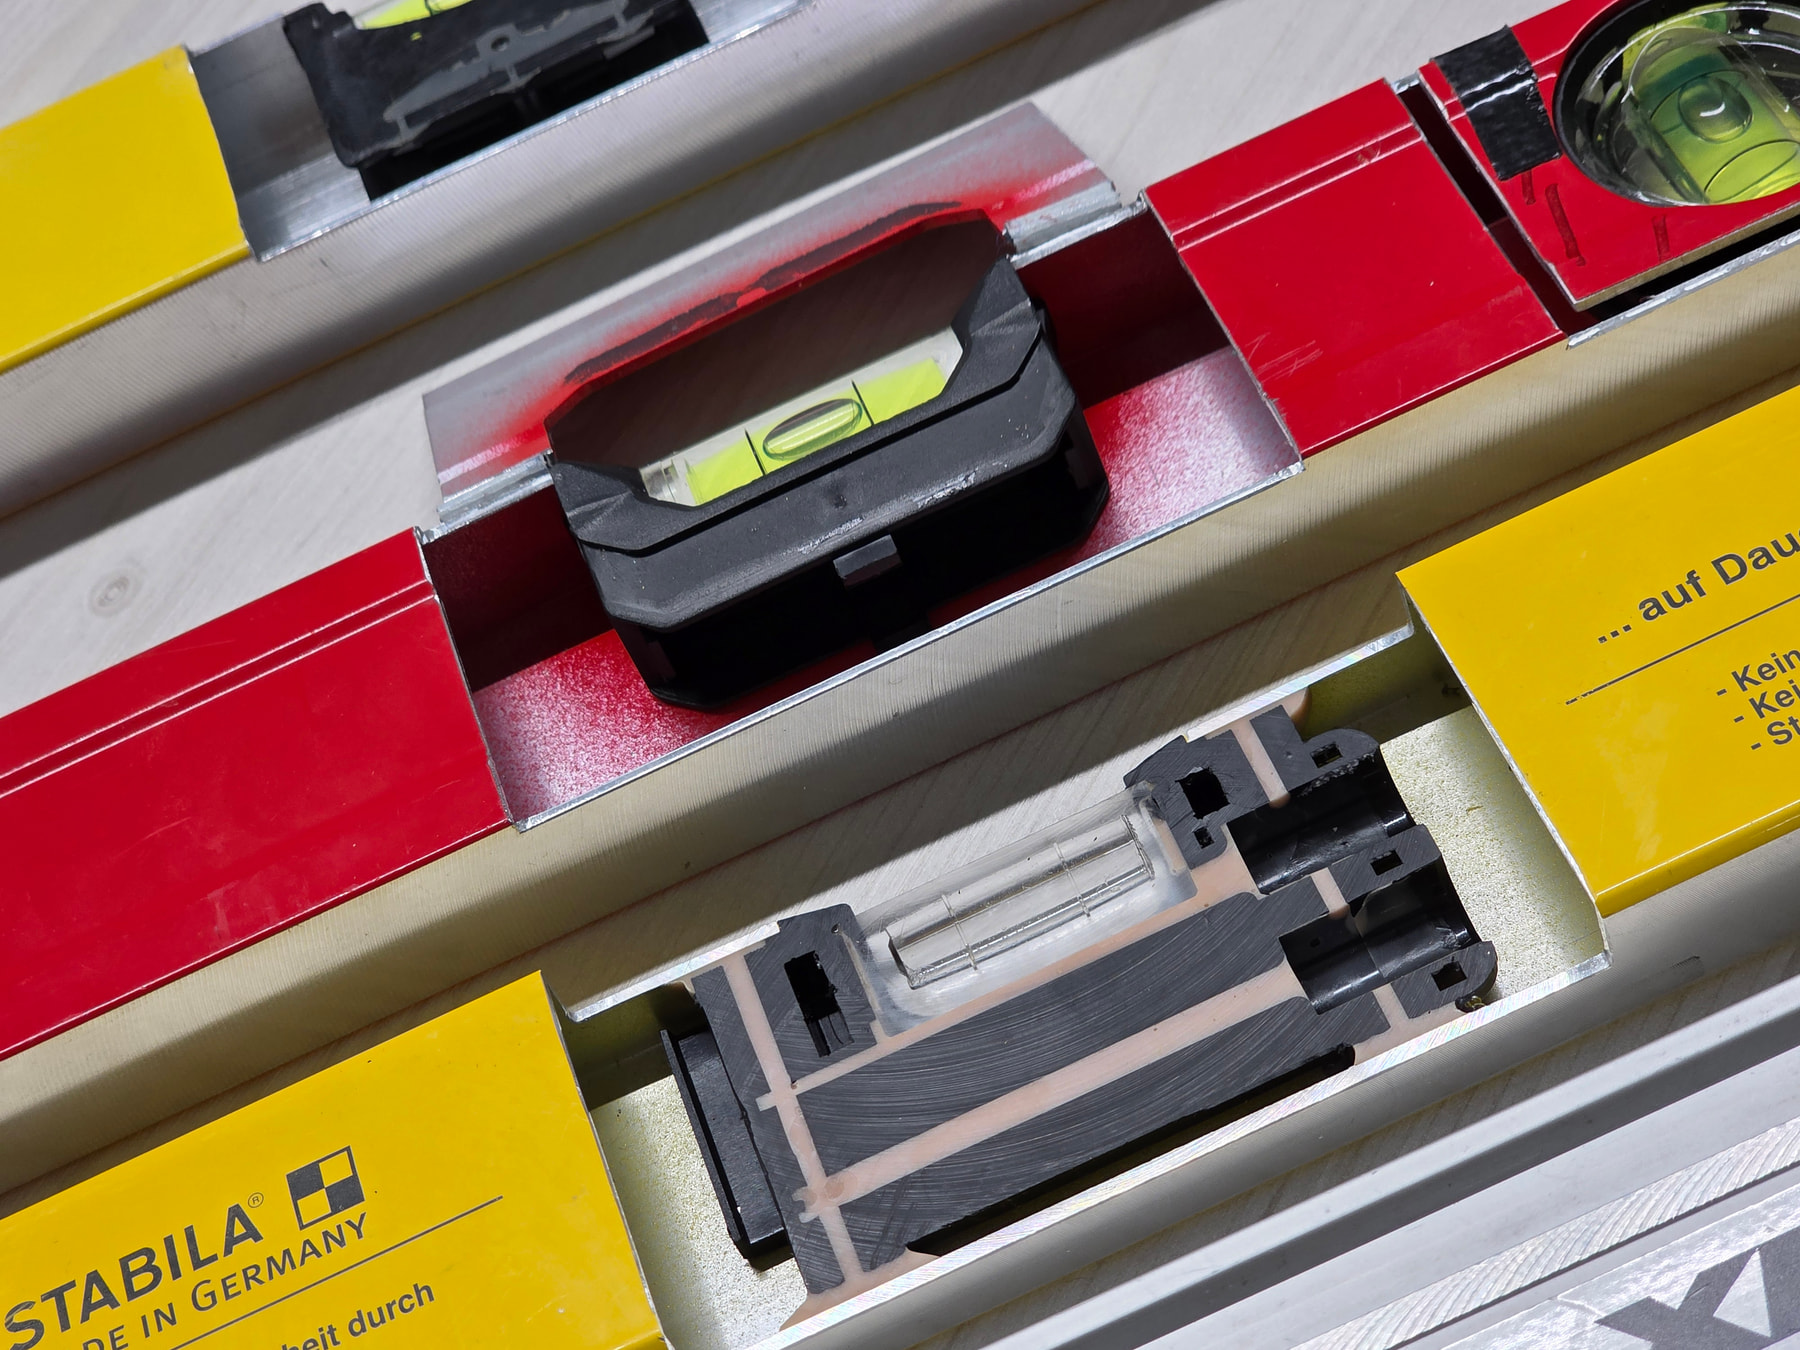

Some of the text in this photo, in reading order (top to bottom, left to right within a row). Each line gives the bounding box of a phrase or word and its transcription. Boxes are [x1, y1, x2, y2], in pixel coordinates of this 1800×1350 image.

[1638, 569, 1707, 621] auf
[1710, 527, 1800, 585] Dau
[140, 1302, 177, 1339] IN
[191, 1212, 366, 1312] GERMANY
[347, 1283, 435, 1337] durch
